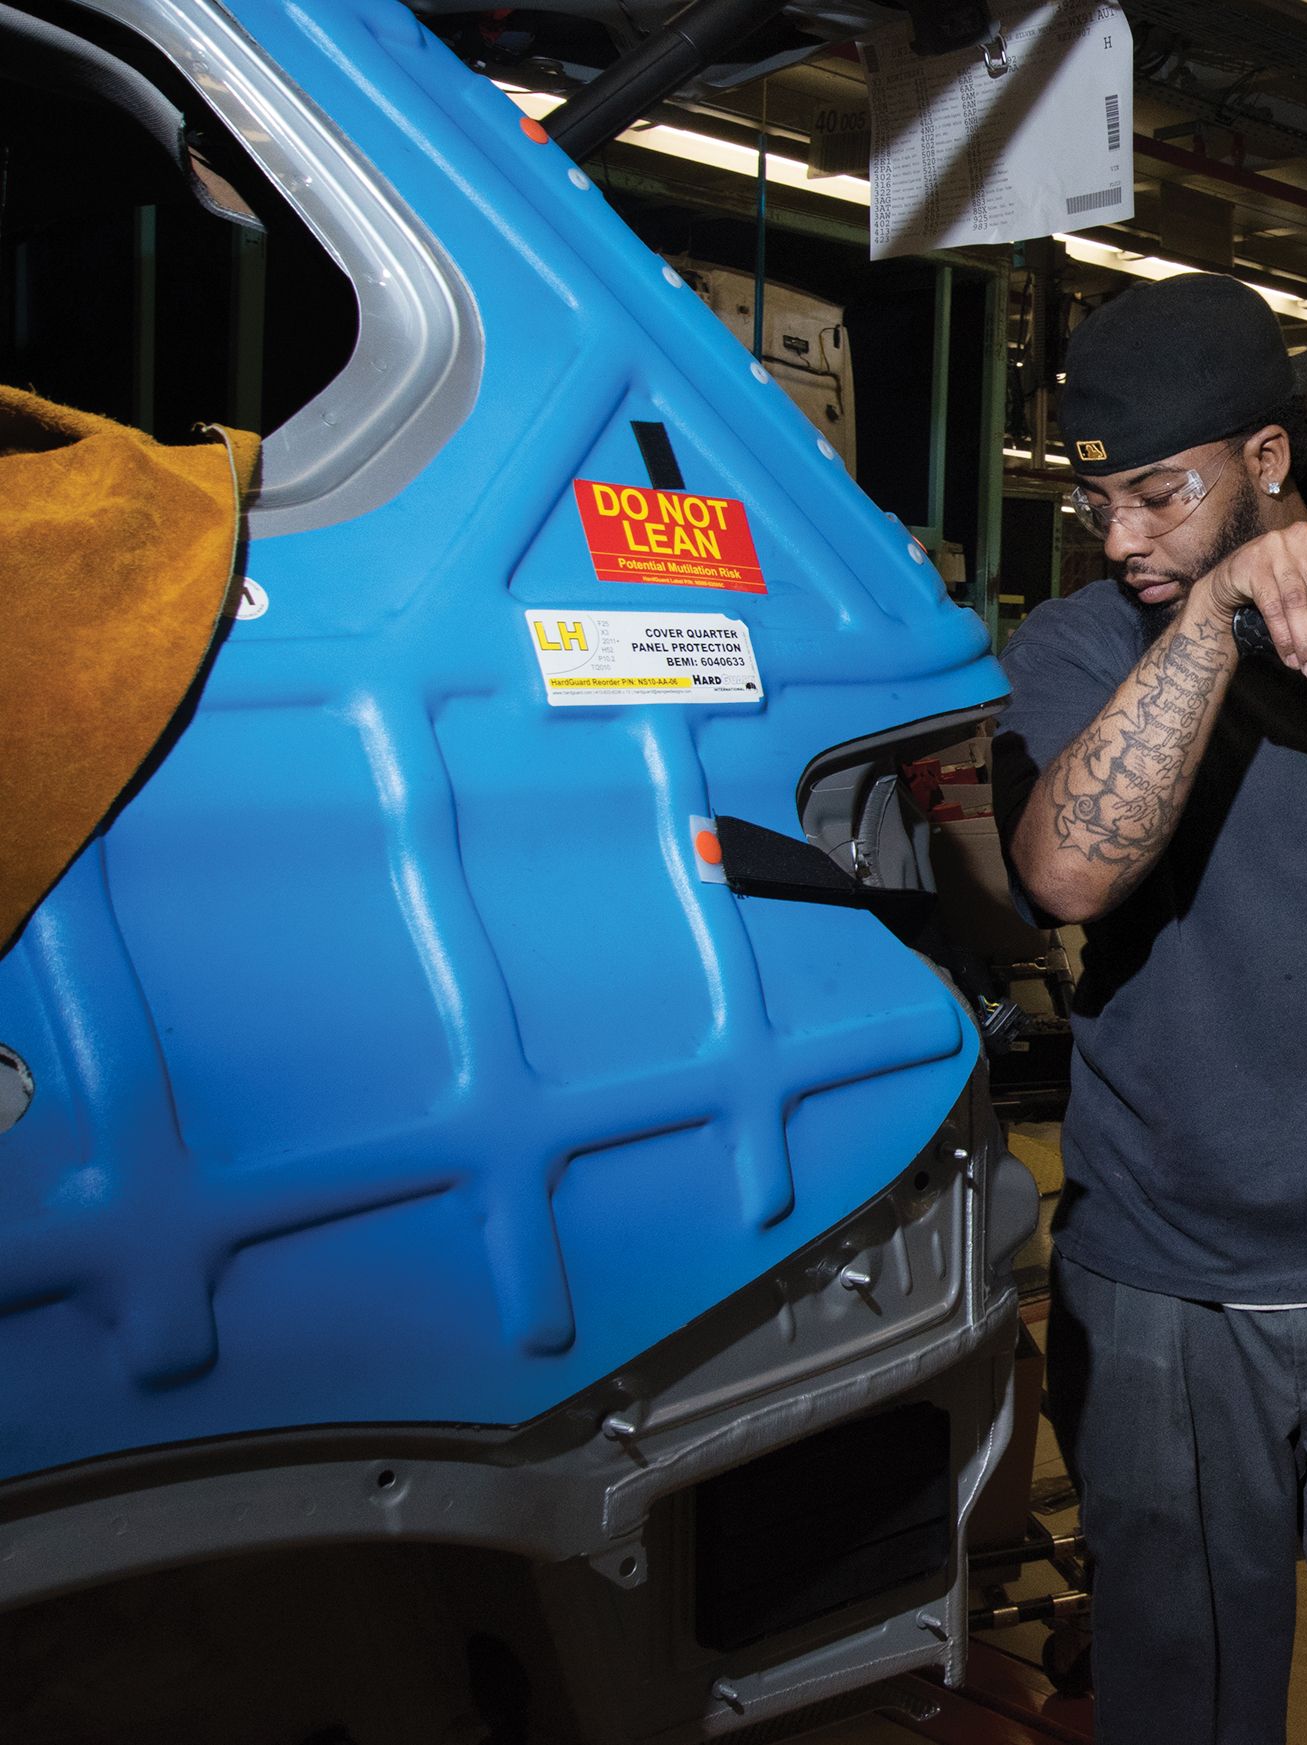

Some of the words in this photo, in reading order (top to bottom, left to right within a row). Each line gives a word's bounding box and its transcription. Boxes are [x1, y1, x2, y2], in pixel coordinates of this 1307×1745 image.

[1104, 36, 1112, 49] H
[921, 142, 935, 150] 502
[923, 158, 936, 166] 520
[923, 166, 937, 174] 521
[874, 181, 891, 189] 316
[874, 189, 891, 197] 322
[592, 484, 649, 520] DO
[656, 493, 728, 530] NOT
[623, 520, 721, 560] LEAN
[618, 558, 666, 572] Potential
[668, 562, 718, 576] Mutilation
[720, 568, 742, 580] Risk
[534, 621, 589, 651] LH
[646, 628, 684, 638] COVER
[687, 629, 738, 639] QUARTER
[632, 643, 669, 652] PANEL
[672, 643, 741, 652] PROTECTION
[667, 657, 698, 666] BEMI:
[701, 657, 745, 666] 6040633
[552, 678, 590, 686] HardGuard
[592, 678, 620, 686] Reorder
